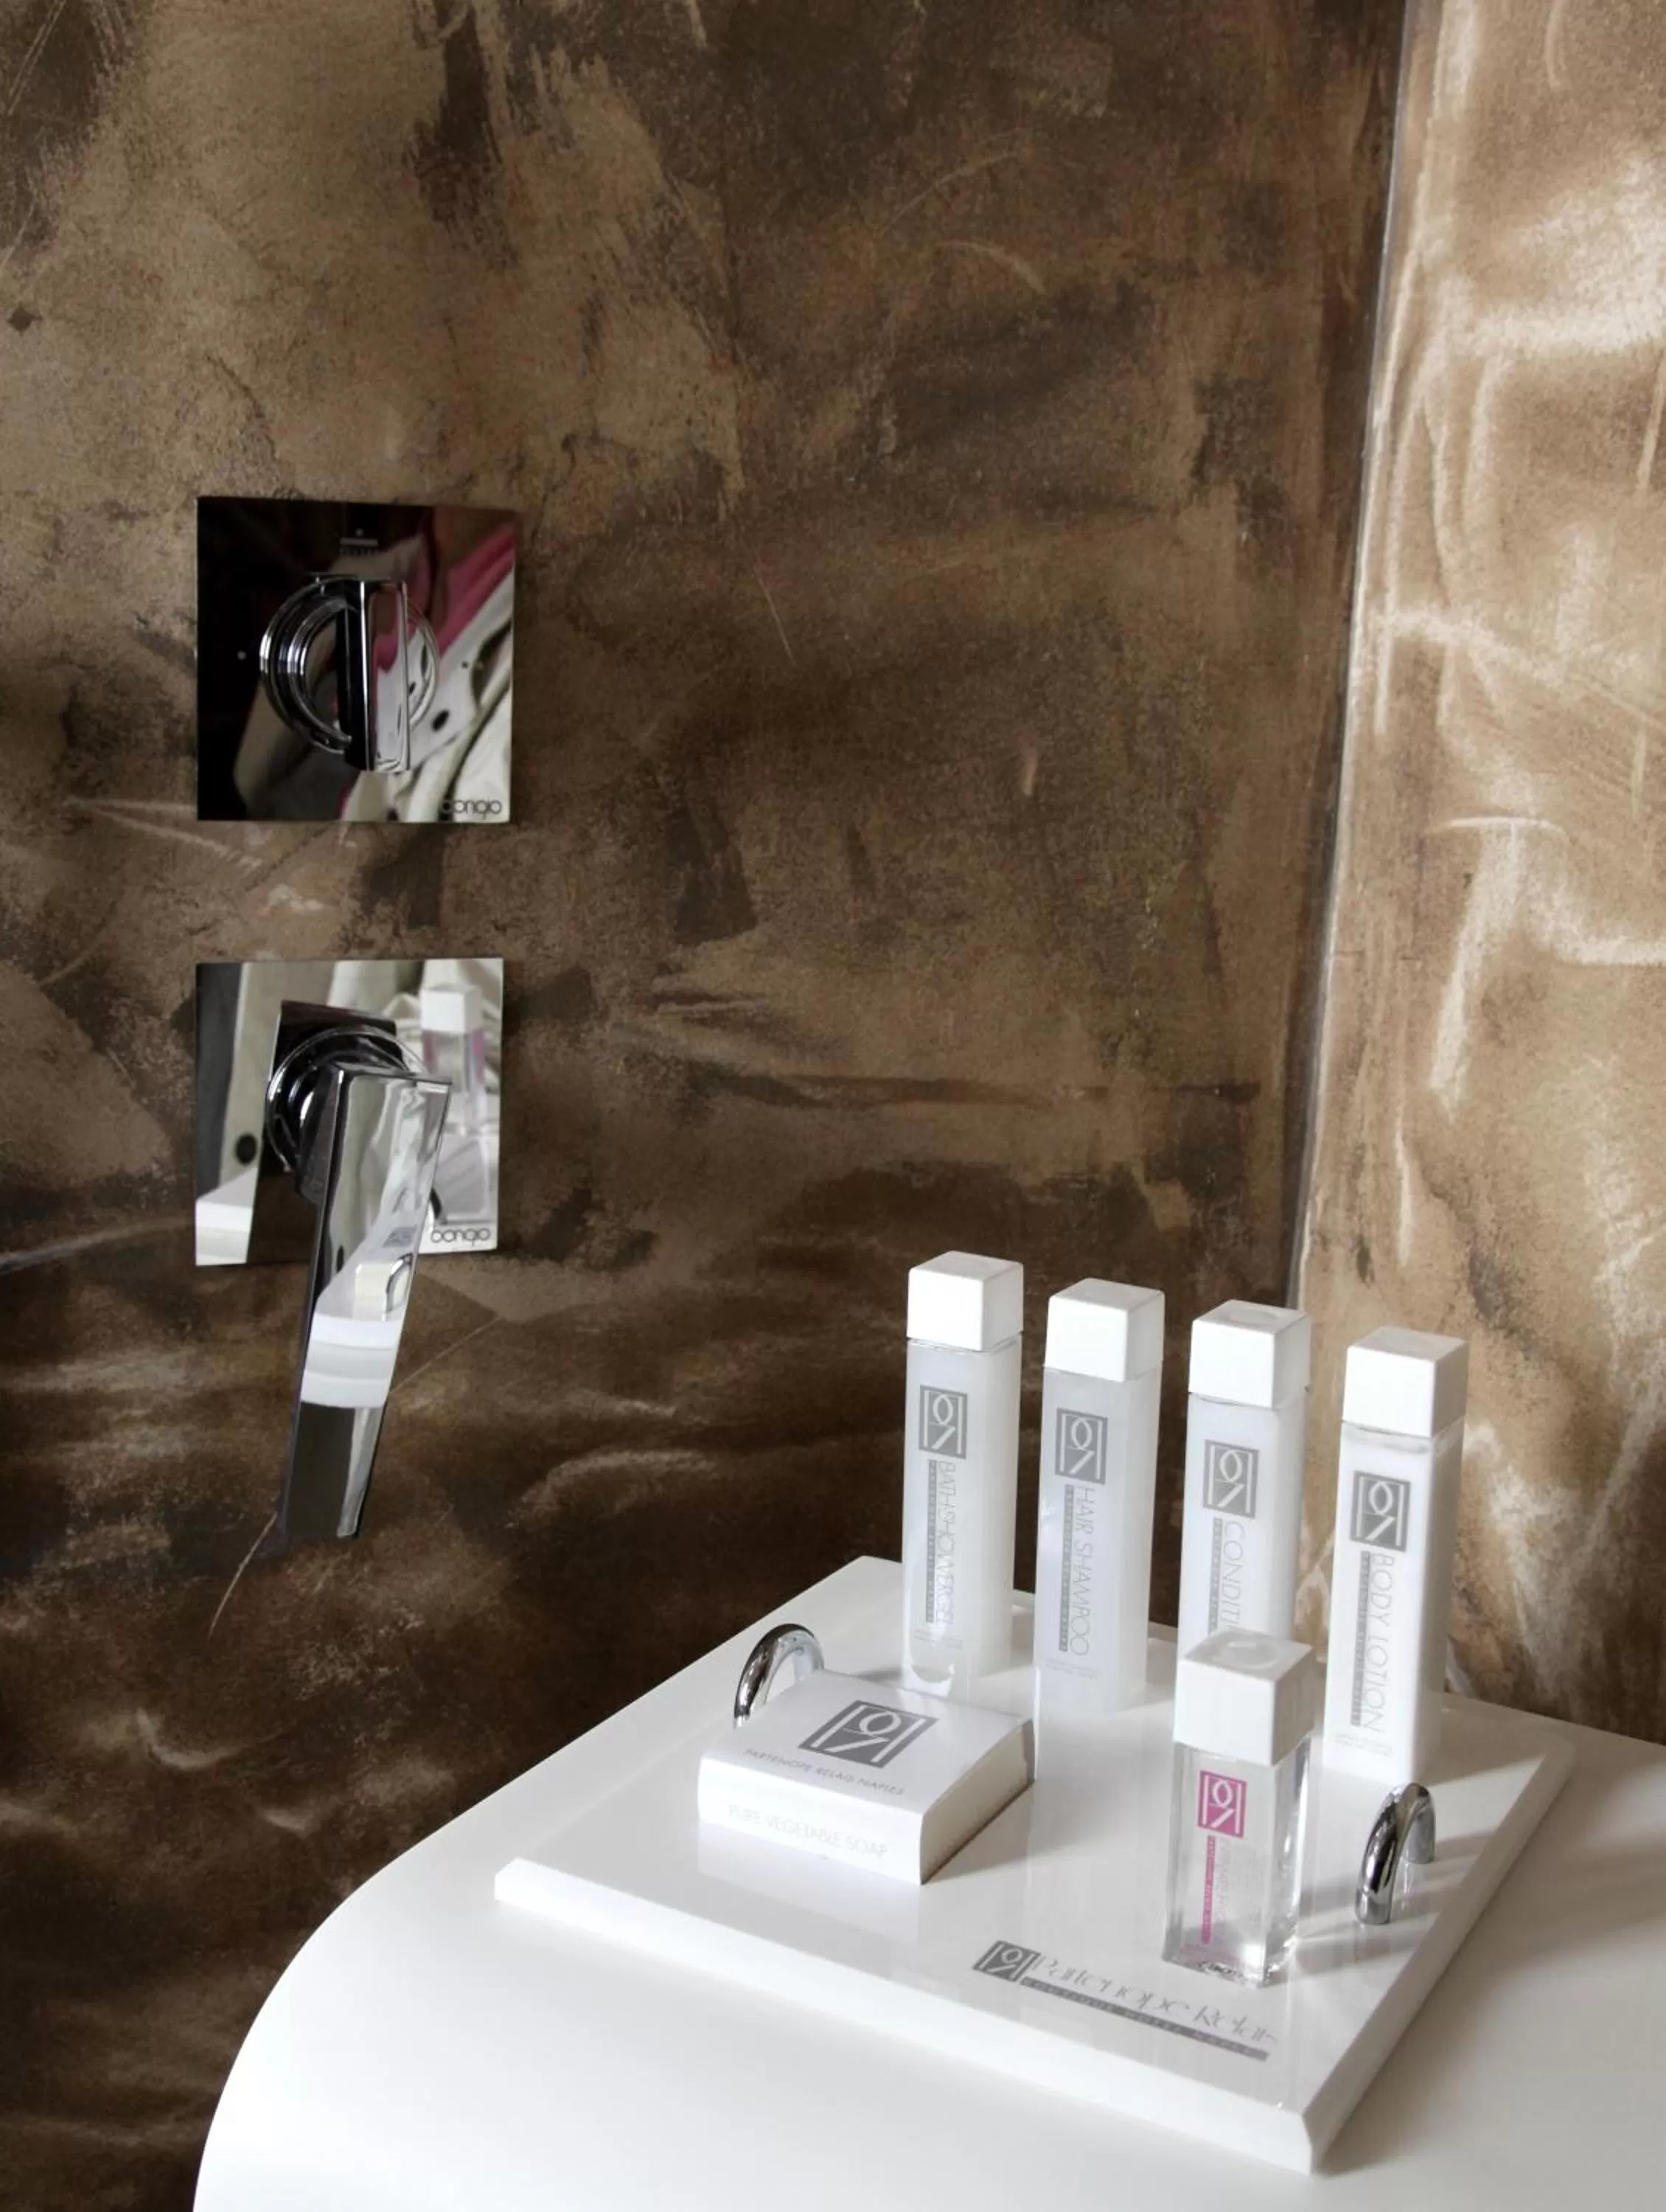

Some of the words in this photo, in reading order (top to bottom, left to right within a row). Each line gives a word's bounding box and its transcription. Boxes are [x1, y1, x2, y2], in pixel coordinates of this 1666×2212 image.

[1220, 1521, 1245, 1628] CONDITI
[1370, 1553, 1395, 1627] BODY
[1362, 1635, 1390, 1733] LOTION
